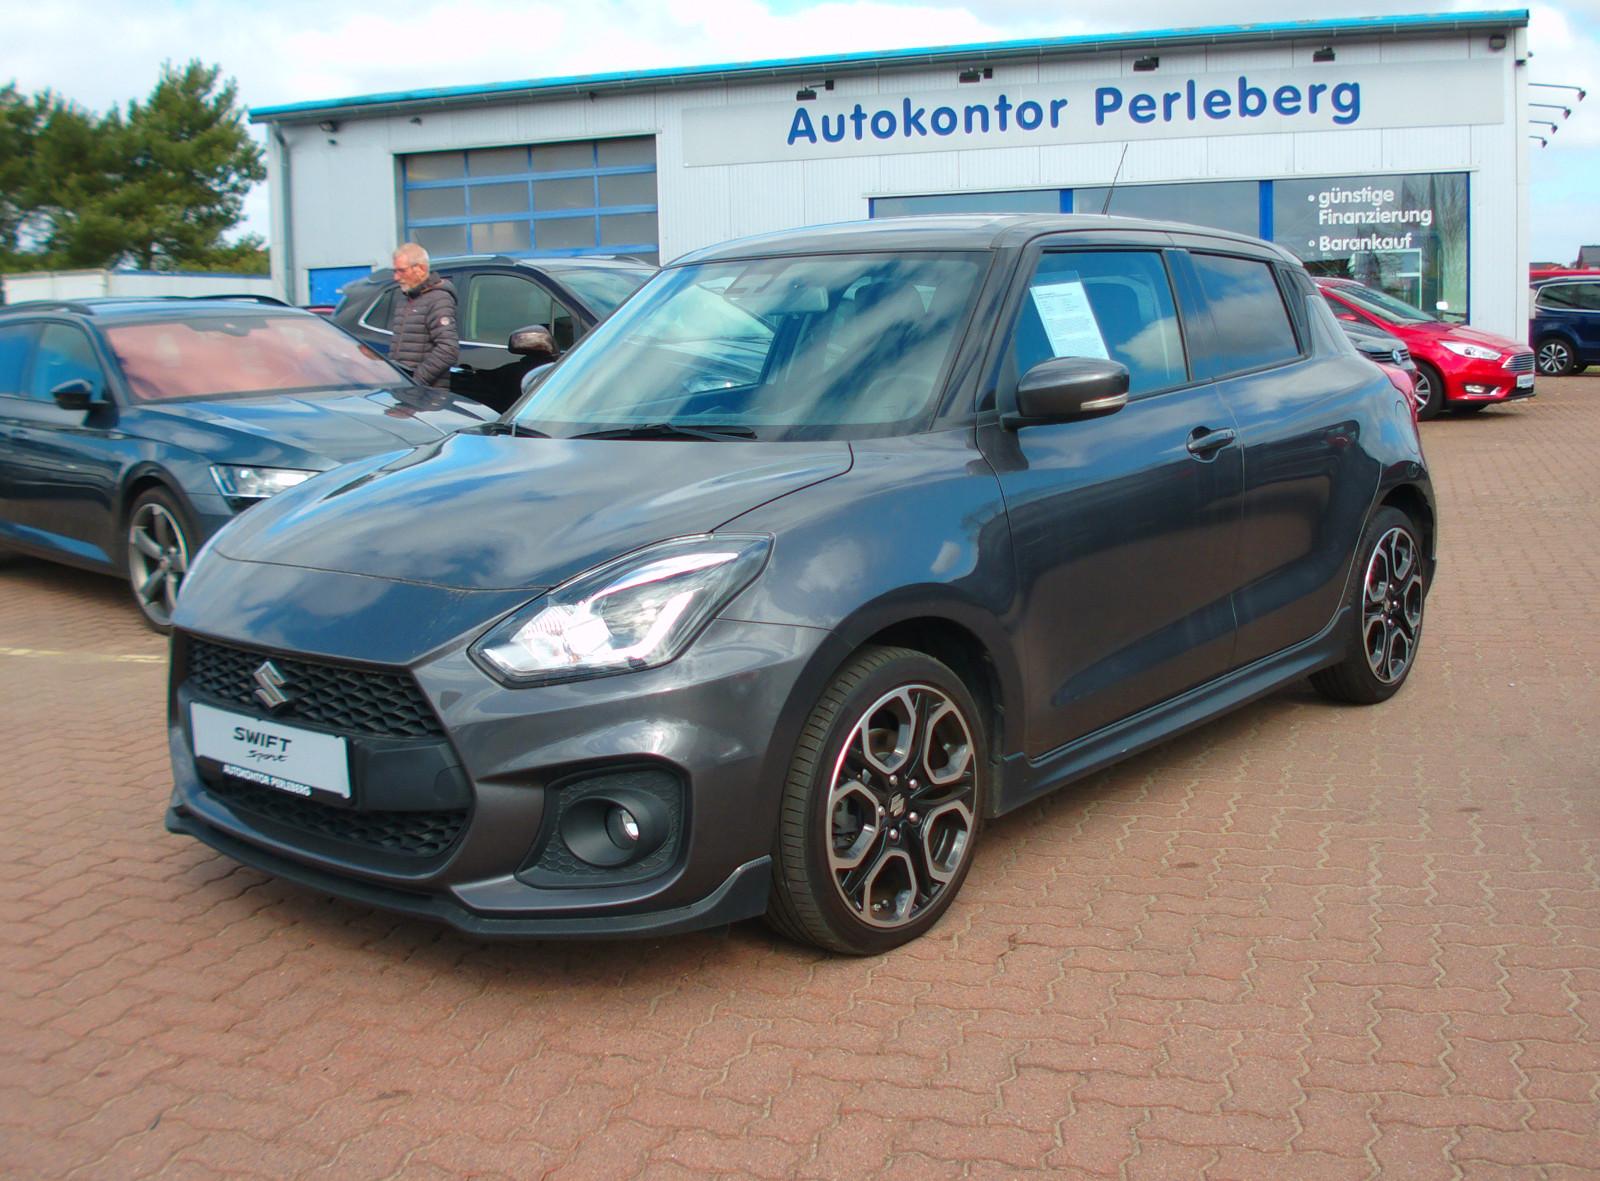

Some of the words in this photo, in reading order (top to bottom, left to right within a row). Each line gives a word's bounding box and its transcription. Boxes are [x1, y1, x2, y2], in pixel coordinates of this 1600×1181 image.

[787, 94, 1067, 145] Autokontor
[1095, 76, 1361, 125] Perleberg
[1318, 187, 1394, 208] günstige
[1318, 208, 1432, 226] Finanzierung
[1319, 233, 1412, 251] Barankauf
[233, 726, 292, 752] SWIFT
